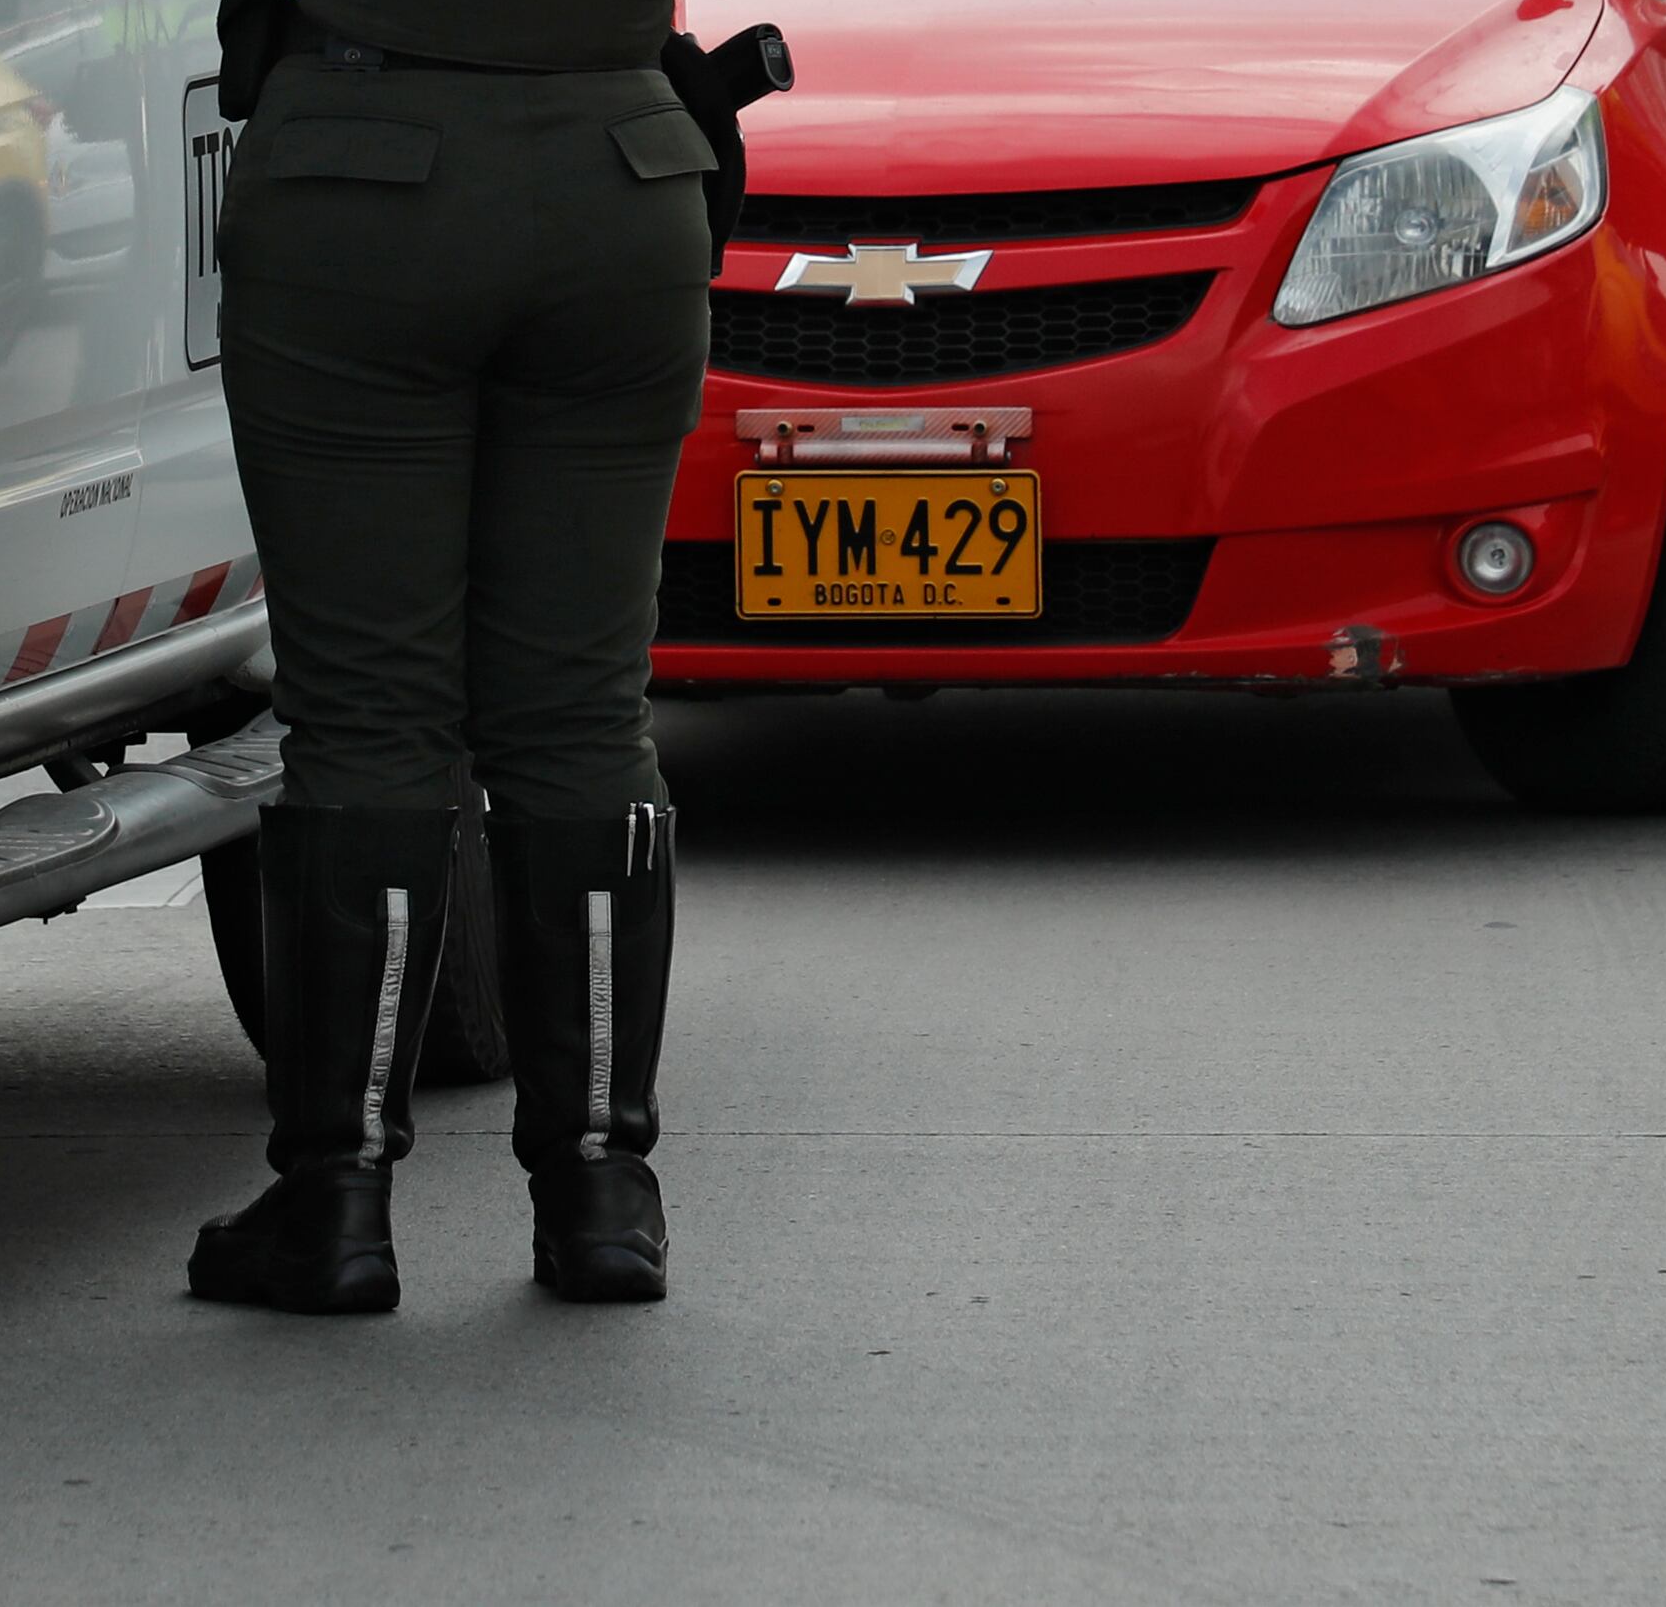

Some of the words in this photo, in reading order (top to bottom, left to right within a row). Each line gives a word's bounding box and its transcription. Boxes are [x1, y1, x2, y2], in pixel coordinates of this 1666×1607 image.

[753, 498, 876, 576] IYM
[900, 498, 1028, 576] 429
[814, 582, 905, 606] BOGOTA
[923, 582, 963, 606] D.C.
